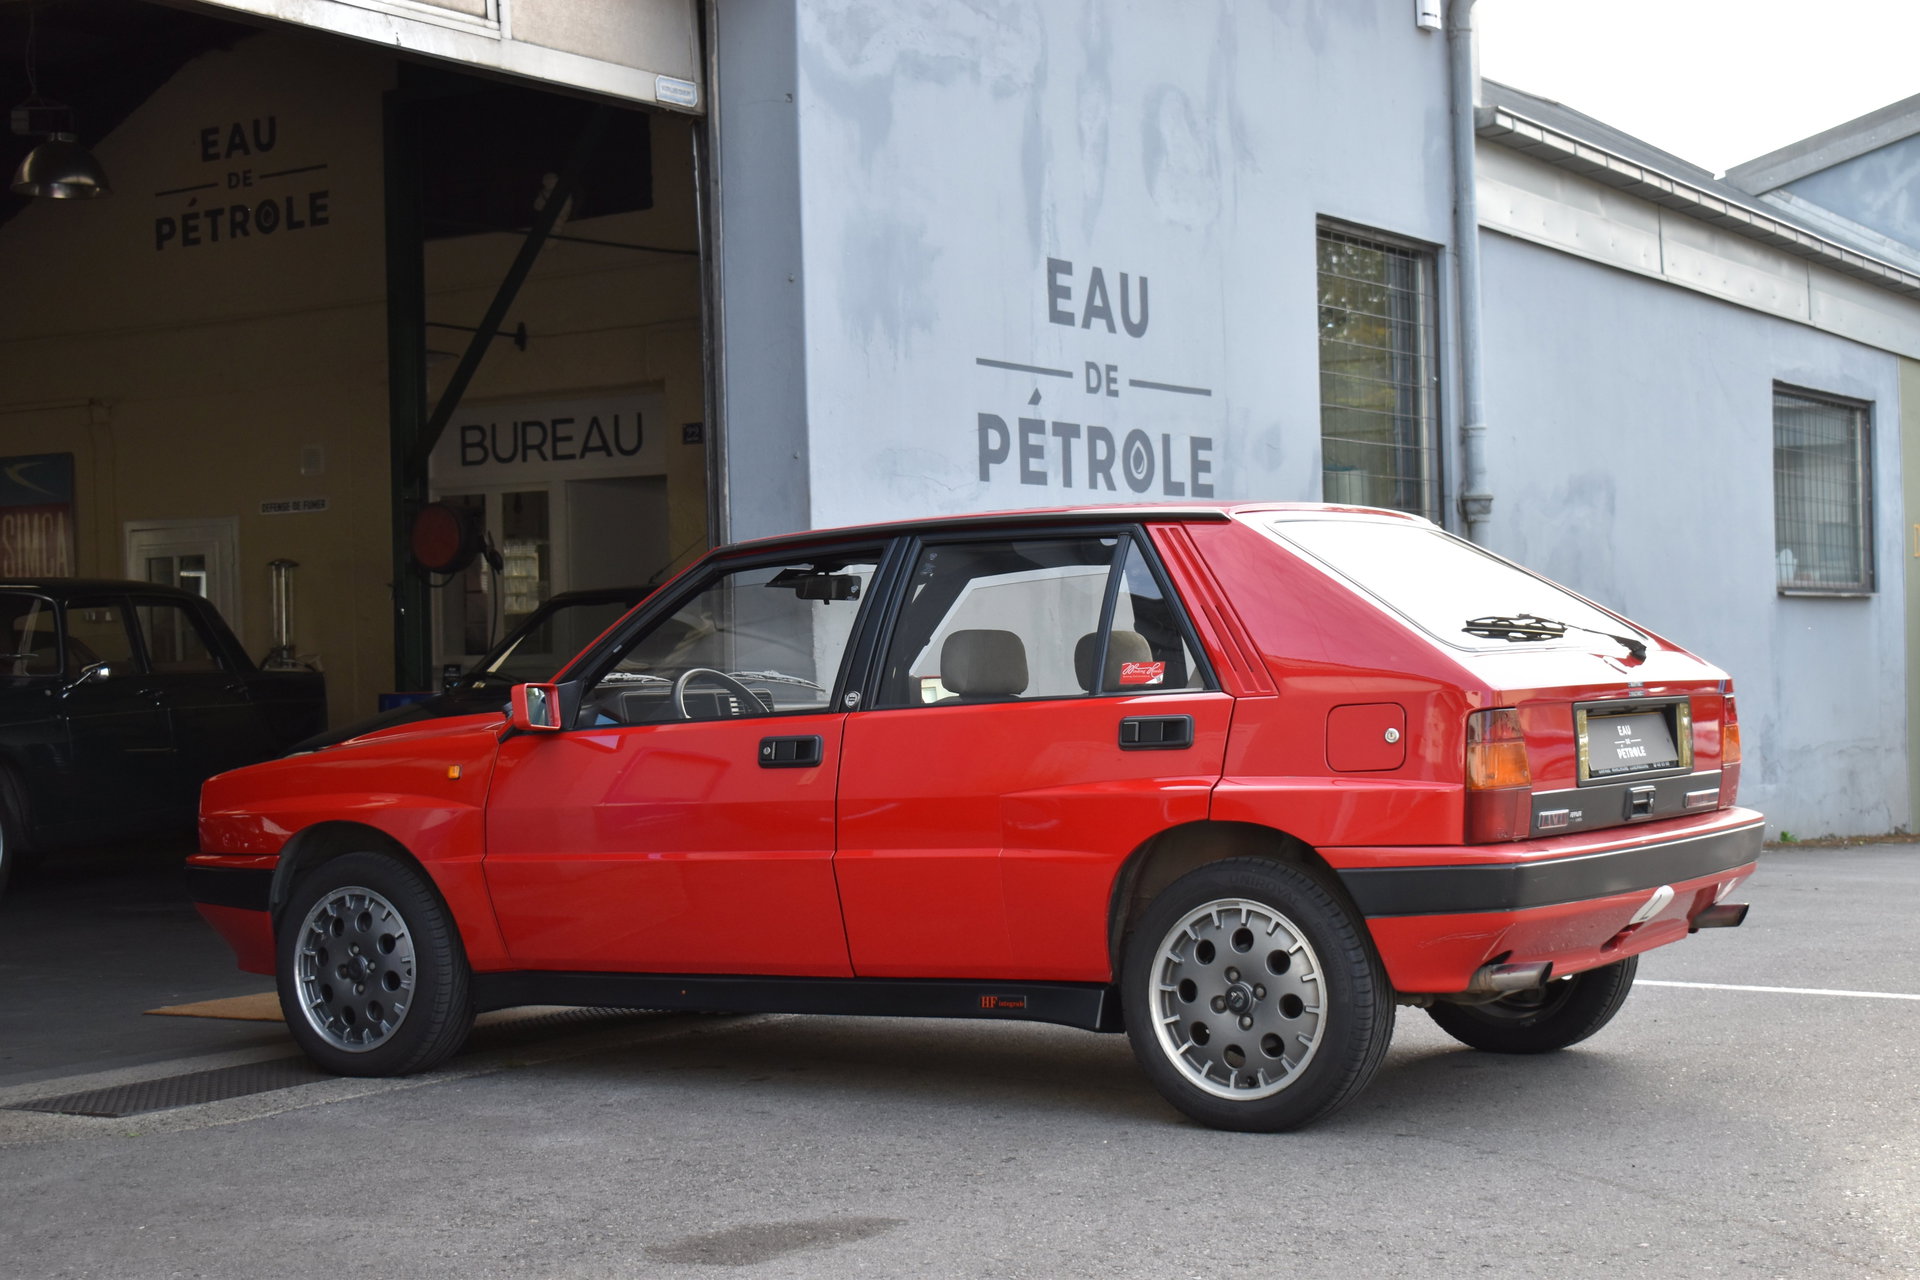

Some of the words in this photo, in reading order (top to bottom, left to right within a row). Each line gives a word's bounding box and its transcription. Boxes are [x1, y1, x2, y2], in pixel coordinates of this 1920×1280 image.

[201, 116, 277, 161] EAU
[227, 169, 253, 188] DE
[155, 190, 330, 251] PÉTROLE
[1047, 257, 1149, 339] EAU
[1085, 361, 1120, 398] DE
[461, 412, 643, 466] BUREAU
[978, 388, 1214, 498] PÉTROLE
[2, 512, 69, 577] SIMCA
[1617, 725, 1632, 736] EAU
[981, 996, 998, 1008] HF
